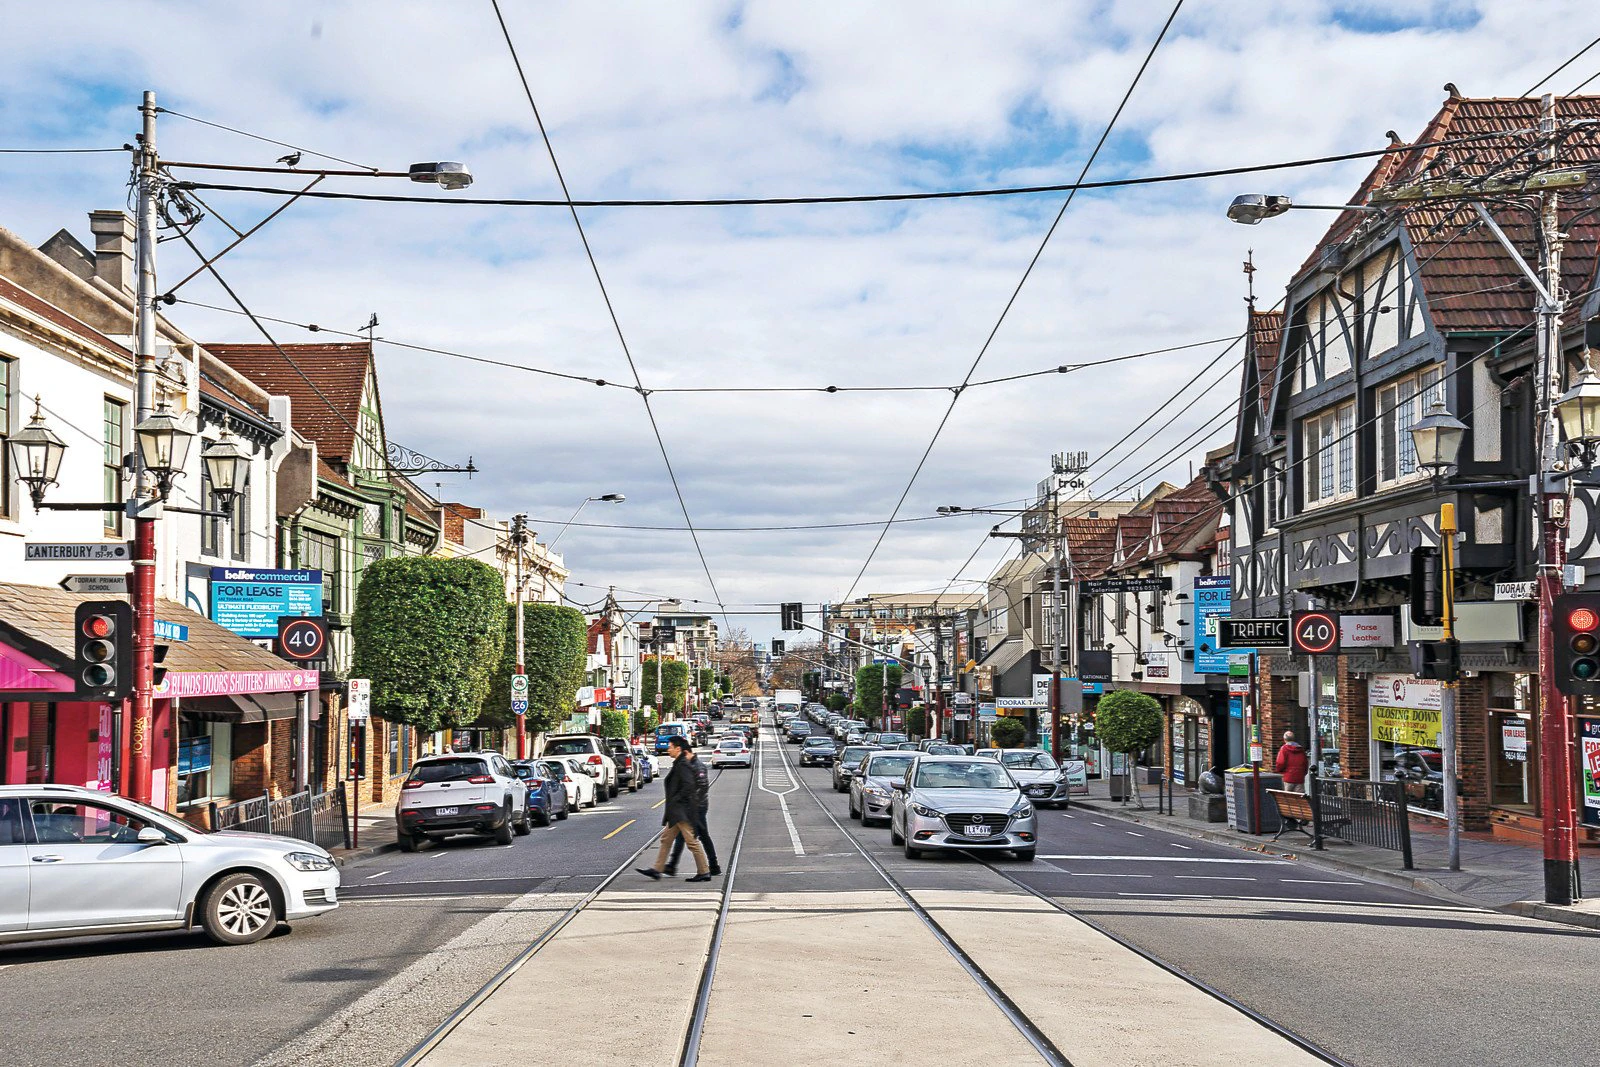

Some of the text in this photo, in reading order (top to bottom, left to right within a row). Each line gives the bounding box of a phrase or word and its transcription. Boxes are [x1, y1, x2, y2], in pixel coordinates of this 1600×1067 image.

[1059, 478, 1084, 488] trak
[27, 546, 92, 557] CANTERBURY
[255, 572, 310, 581] commercial
[218, 586, 243, 596] FOR
[247, 587, 282, 598] LEASE
[1496, 583, 1526, 594] TOORAK
[1199, 592, 1218, 601] FOR
[1231, 623, 1283, 638] TRAFFIC
[1302, 624, 1329, 641] 40
[289, 630, 316, 647] 40
[172, 674, 200, 695] BLINDS
[203, 673, 228, 693] DOORS
[230, 673, 262, 691] SHUTTERS
[264, 673, 292, 690] AWNINGS
[514, 701, 525, 710] 26
[1376, 708, 1440, 722] CLOSING DOWN
[132, 716, 144, 755] TOORAK
[1504, 729, 1526, 738] FOR LEASE
[1585, 741, 1600, 753] FO
[1590, 754, 1600, 774] LE
